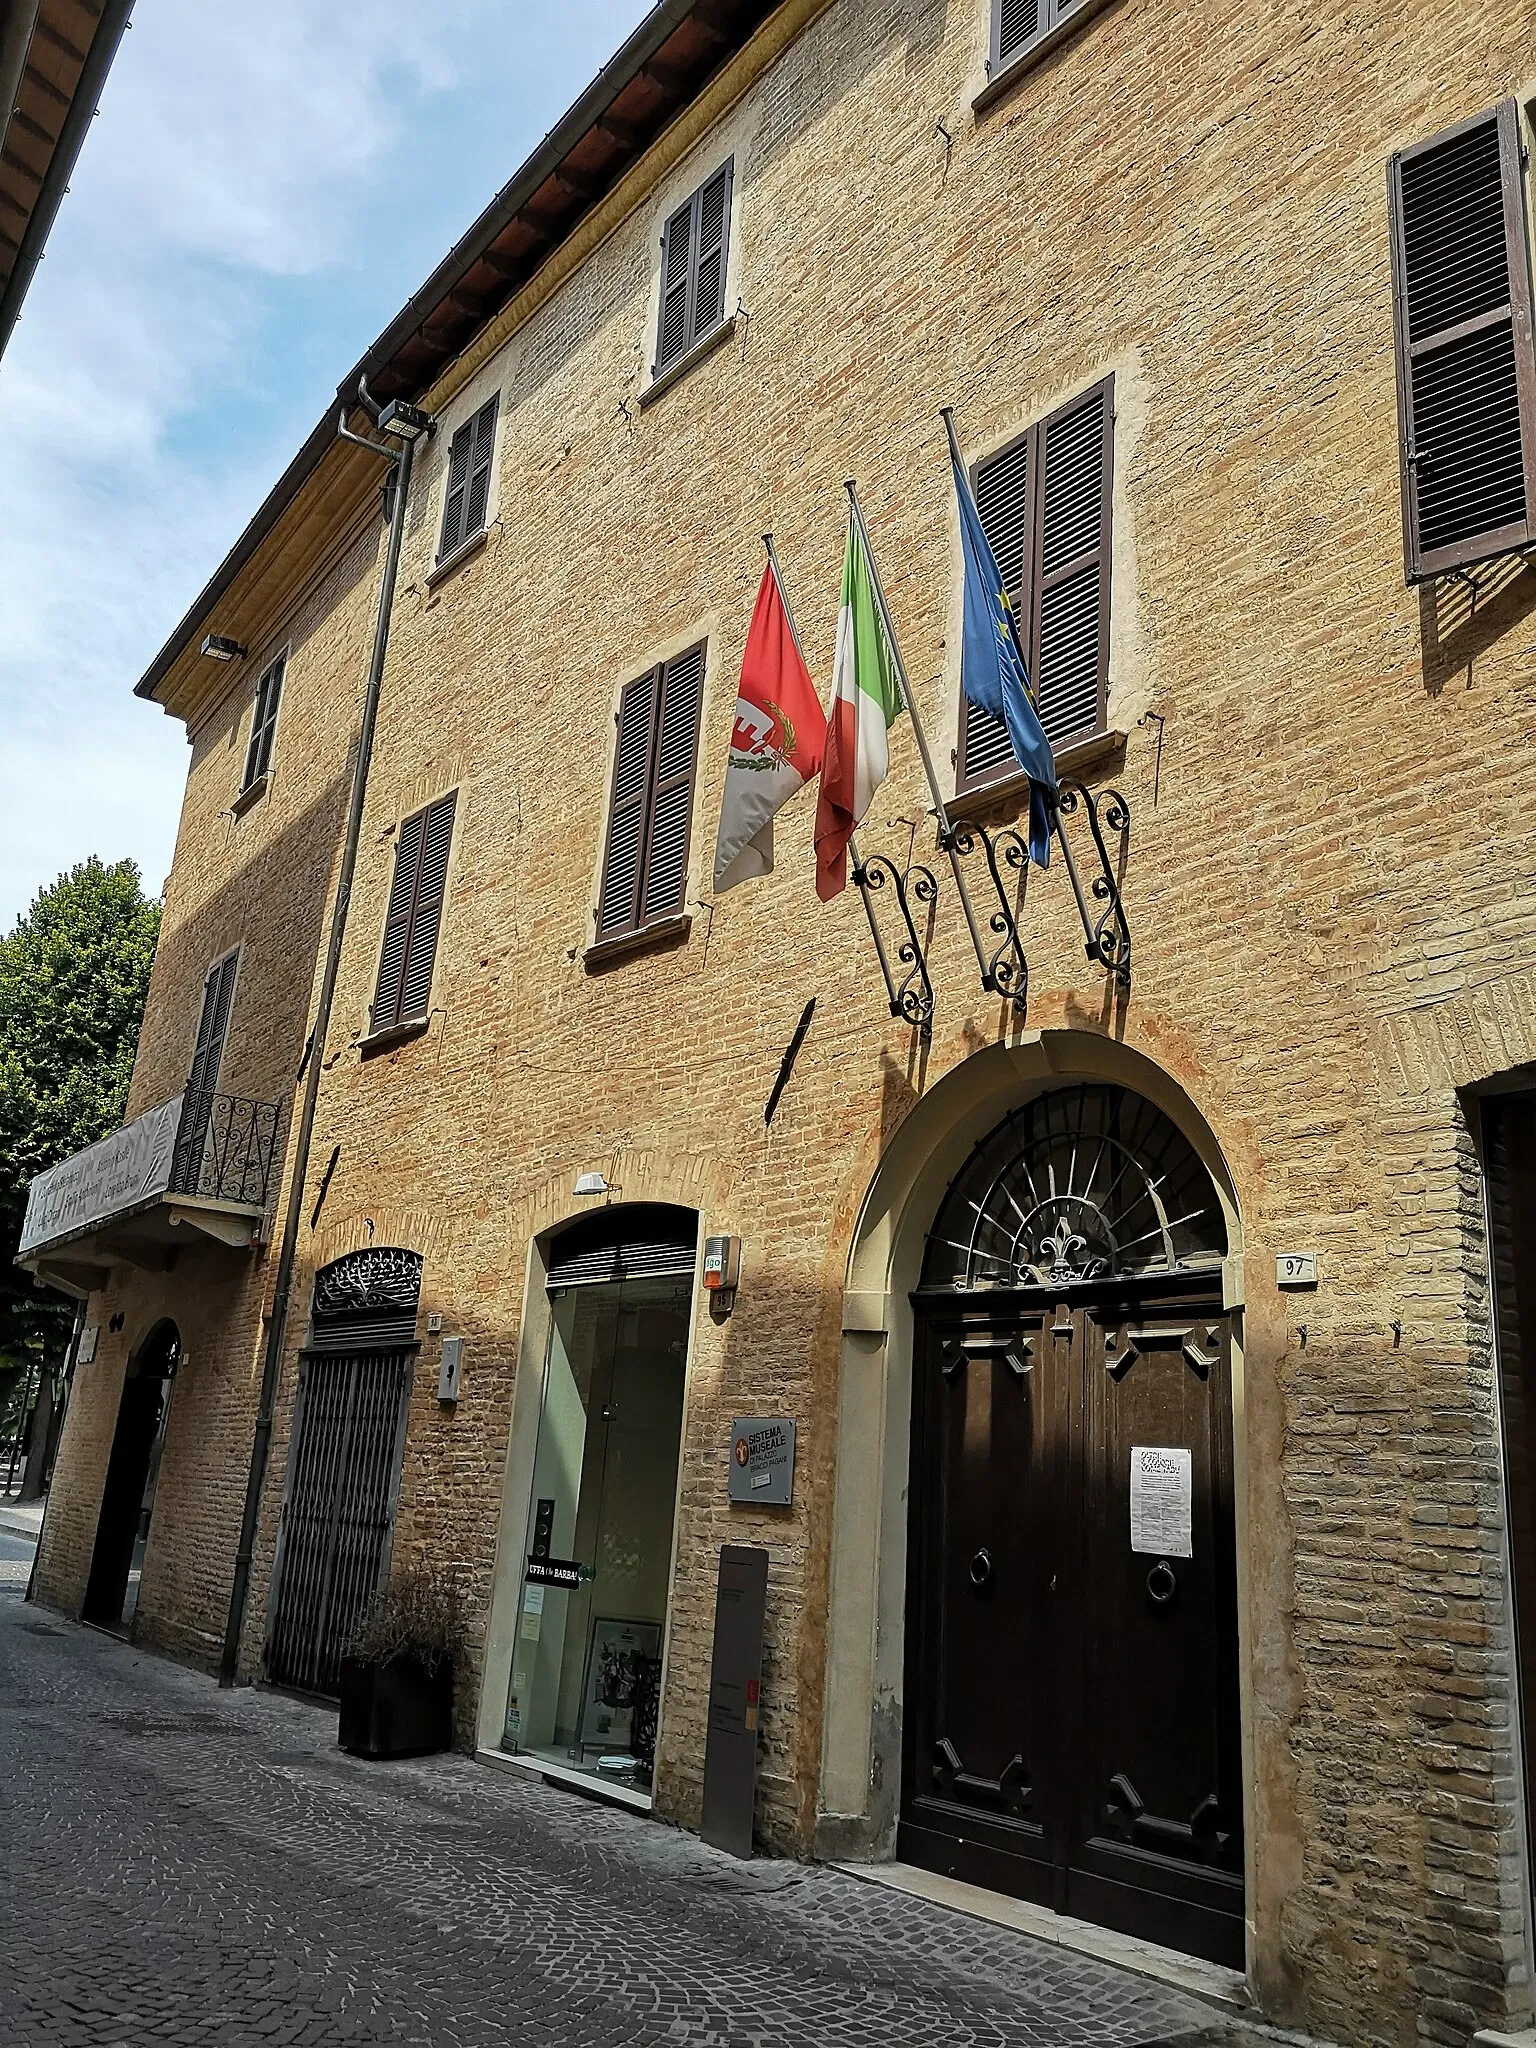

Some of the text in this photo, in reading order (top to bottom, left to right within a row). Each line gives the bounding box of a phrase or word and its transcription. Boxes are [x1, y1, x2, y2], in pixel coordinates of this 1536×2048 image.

[1286, 1260, 1303, 1276] 97
[748, 1426, 782, 1445] SISTEMA
[749, 1435, 787, 1456] MUSEALE
[750, 1450, 777, 1465] DI PALAZZO
[529, 1564, 545, 1576] UFFA
[554, 1568, 578, 1581] BARBA!
